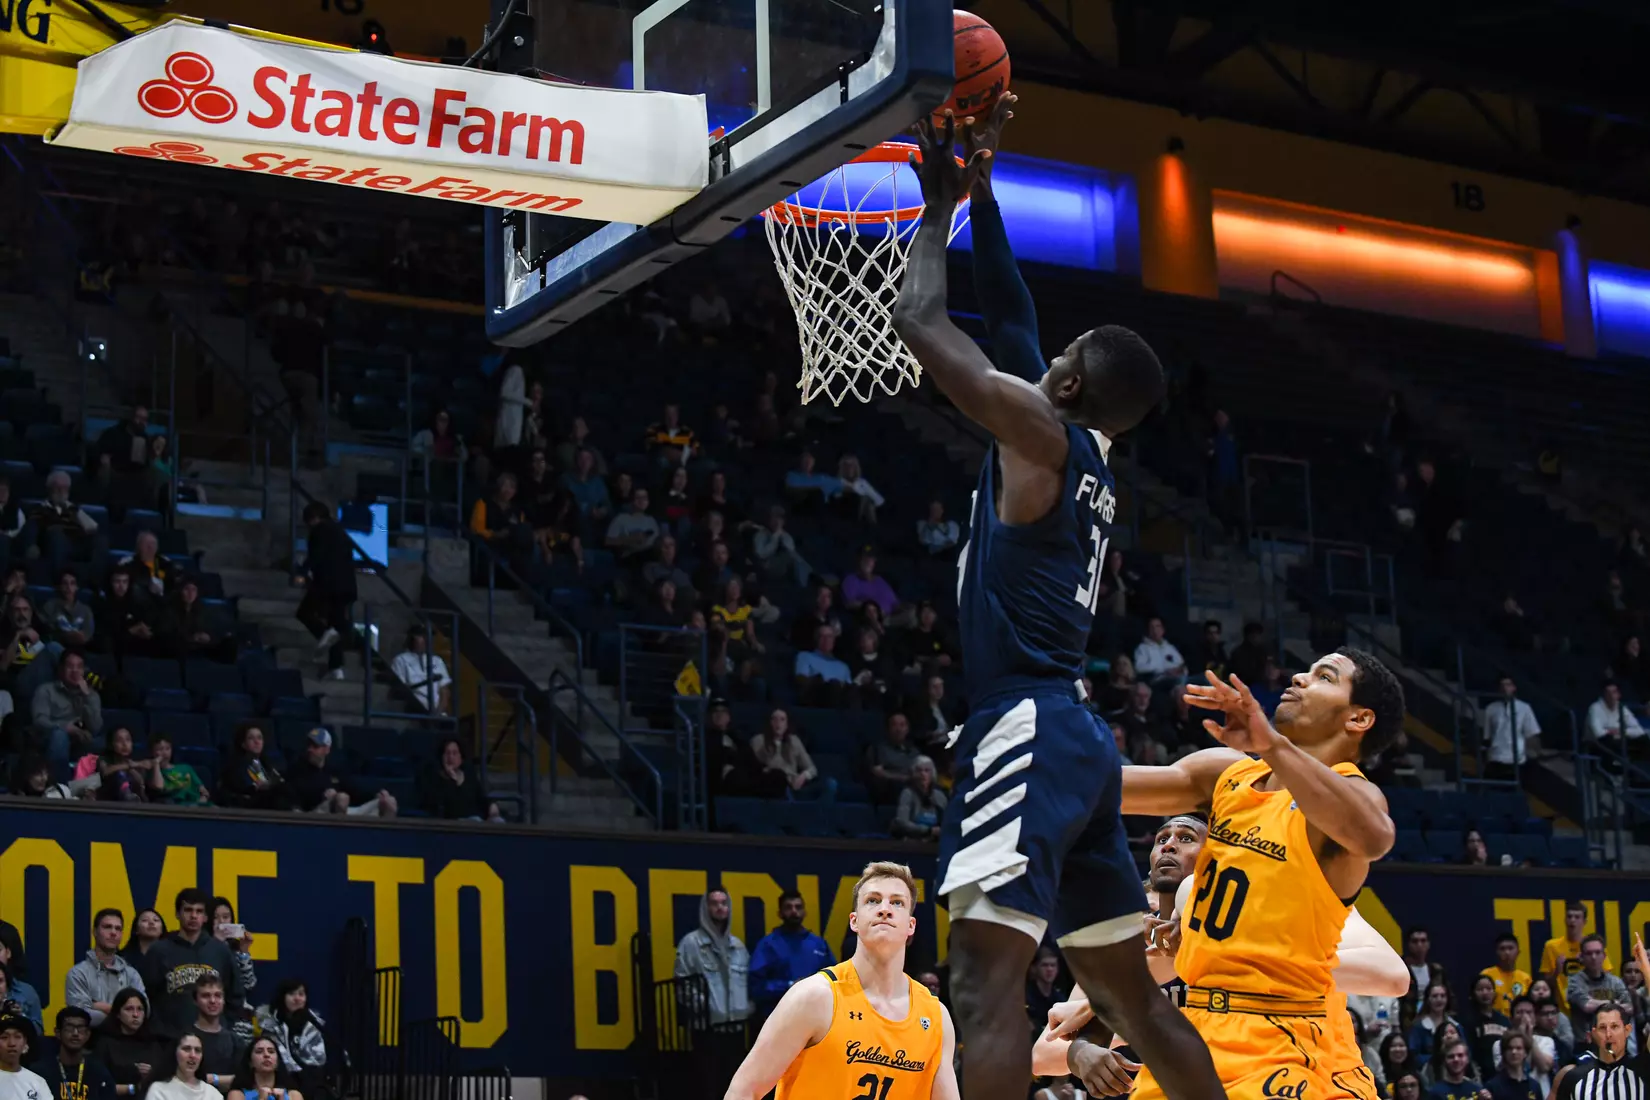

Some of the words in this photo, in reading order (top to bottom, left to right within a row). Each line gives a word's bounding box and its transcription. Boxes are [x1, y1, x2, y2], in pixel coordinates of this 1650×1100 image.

[1188, 857, 1251, 942] 20
[347, 854, 508, 1049] TO
[846, 1040, 890, 1065] Golden
[890, 1049, 926, 1071] Bears
[1262, 1067, 1308, 1100] Cal
